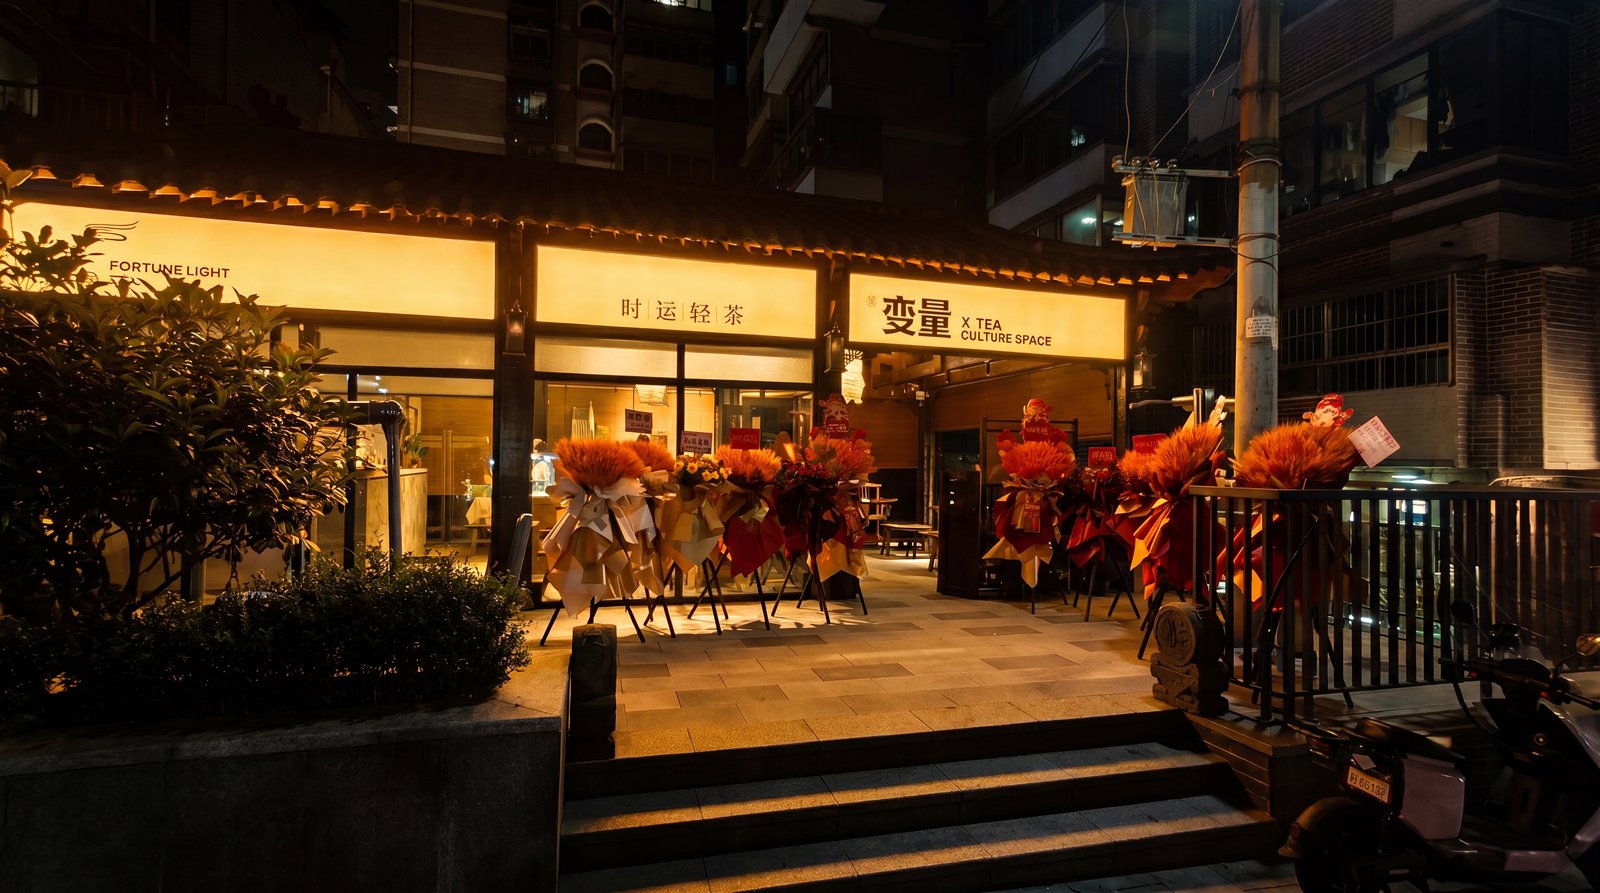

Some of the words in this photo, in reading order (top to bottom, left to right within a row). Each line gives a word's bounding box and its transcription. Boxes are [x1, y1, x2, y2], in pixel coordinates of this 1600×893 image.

[110, 260, 183, 275] FORTUNE
[187, 266, 230, 278] LIGHT
[621, 298, 744, 326] 时运轻茶
[882, 295, 952, 339] 变量
[961, 316, 970, 329] X
[975, 318, 1002, 331] TEA
[961, 330, 1012, 344] CULTURE
[1015, 334, 1052, 346] SPACE
